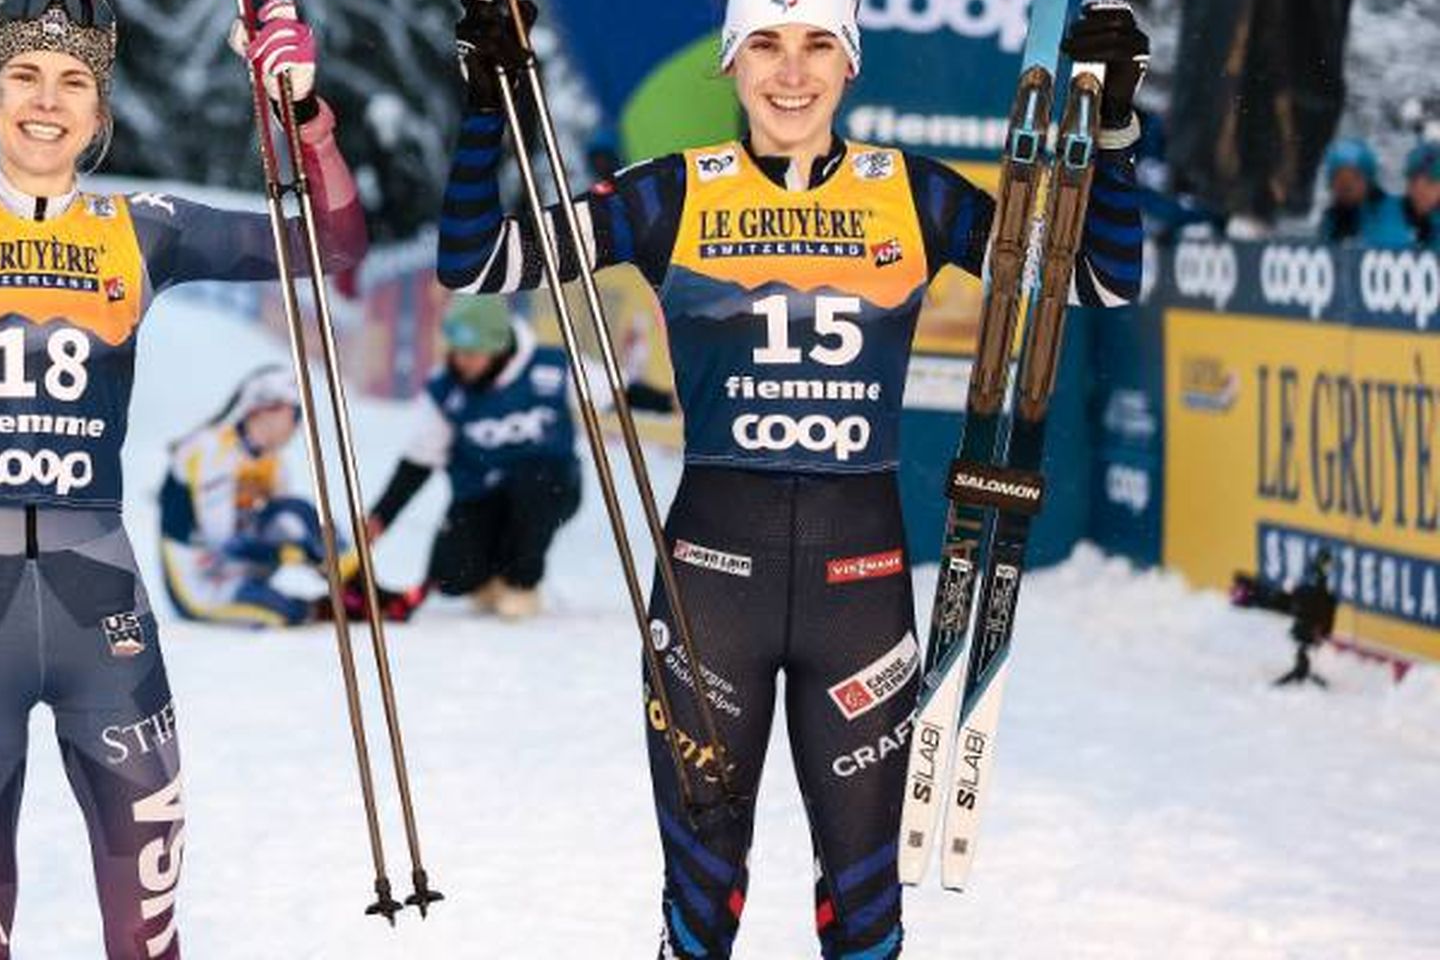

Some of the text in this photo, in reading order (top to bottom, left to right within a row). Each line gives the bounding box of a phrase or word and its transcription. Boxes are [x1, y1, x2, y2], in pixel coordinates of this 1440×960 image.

[699, 202, 865, 240] LE GRUYÈRE
[706, 243, 860, 256] SWITZERLAND
[1261, 245, 1335, 321] coop
[1361, 249, 1440, 331] coop
[751, 294, 863, 365] 15
[725, 376, 881, 401] fiemme
[731, 413, 870, 461] coop
[1258, 364, 1300, 503] LE
[953, 473, 1041, 500] SALOMON
[1264, 530, 1440, 623] SWZERLA
